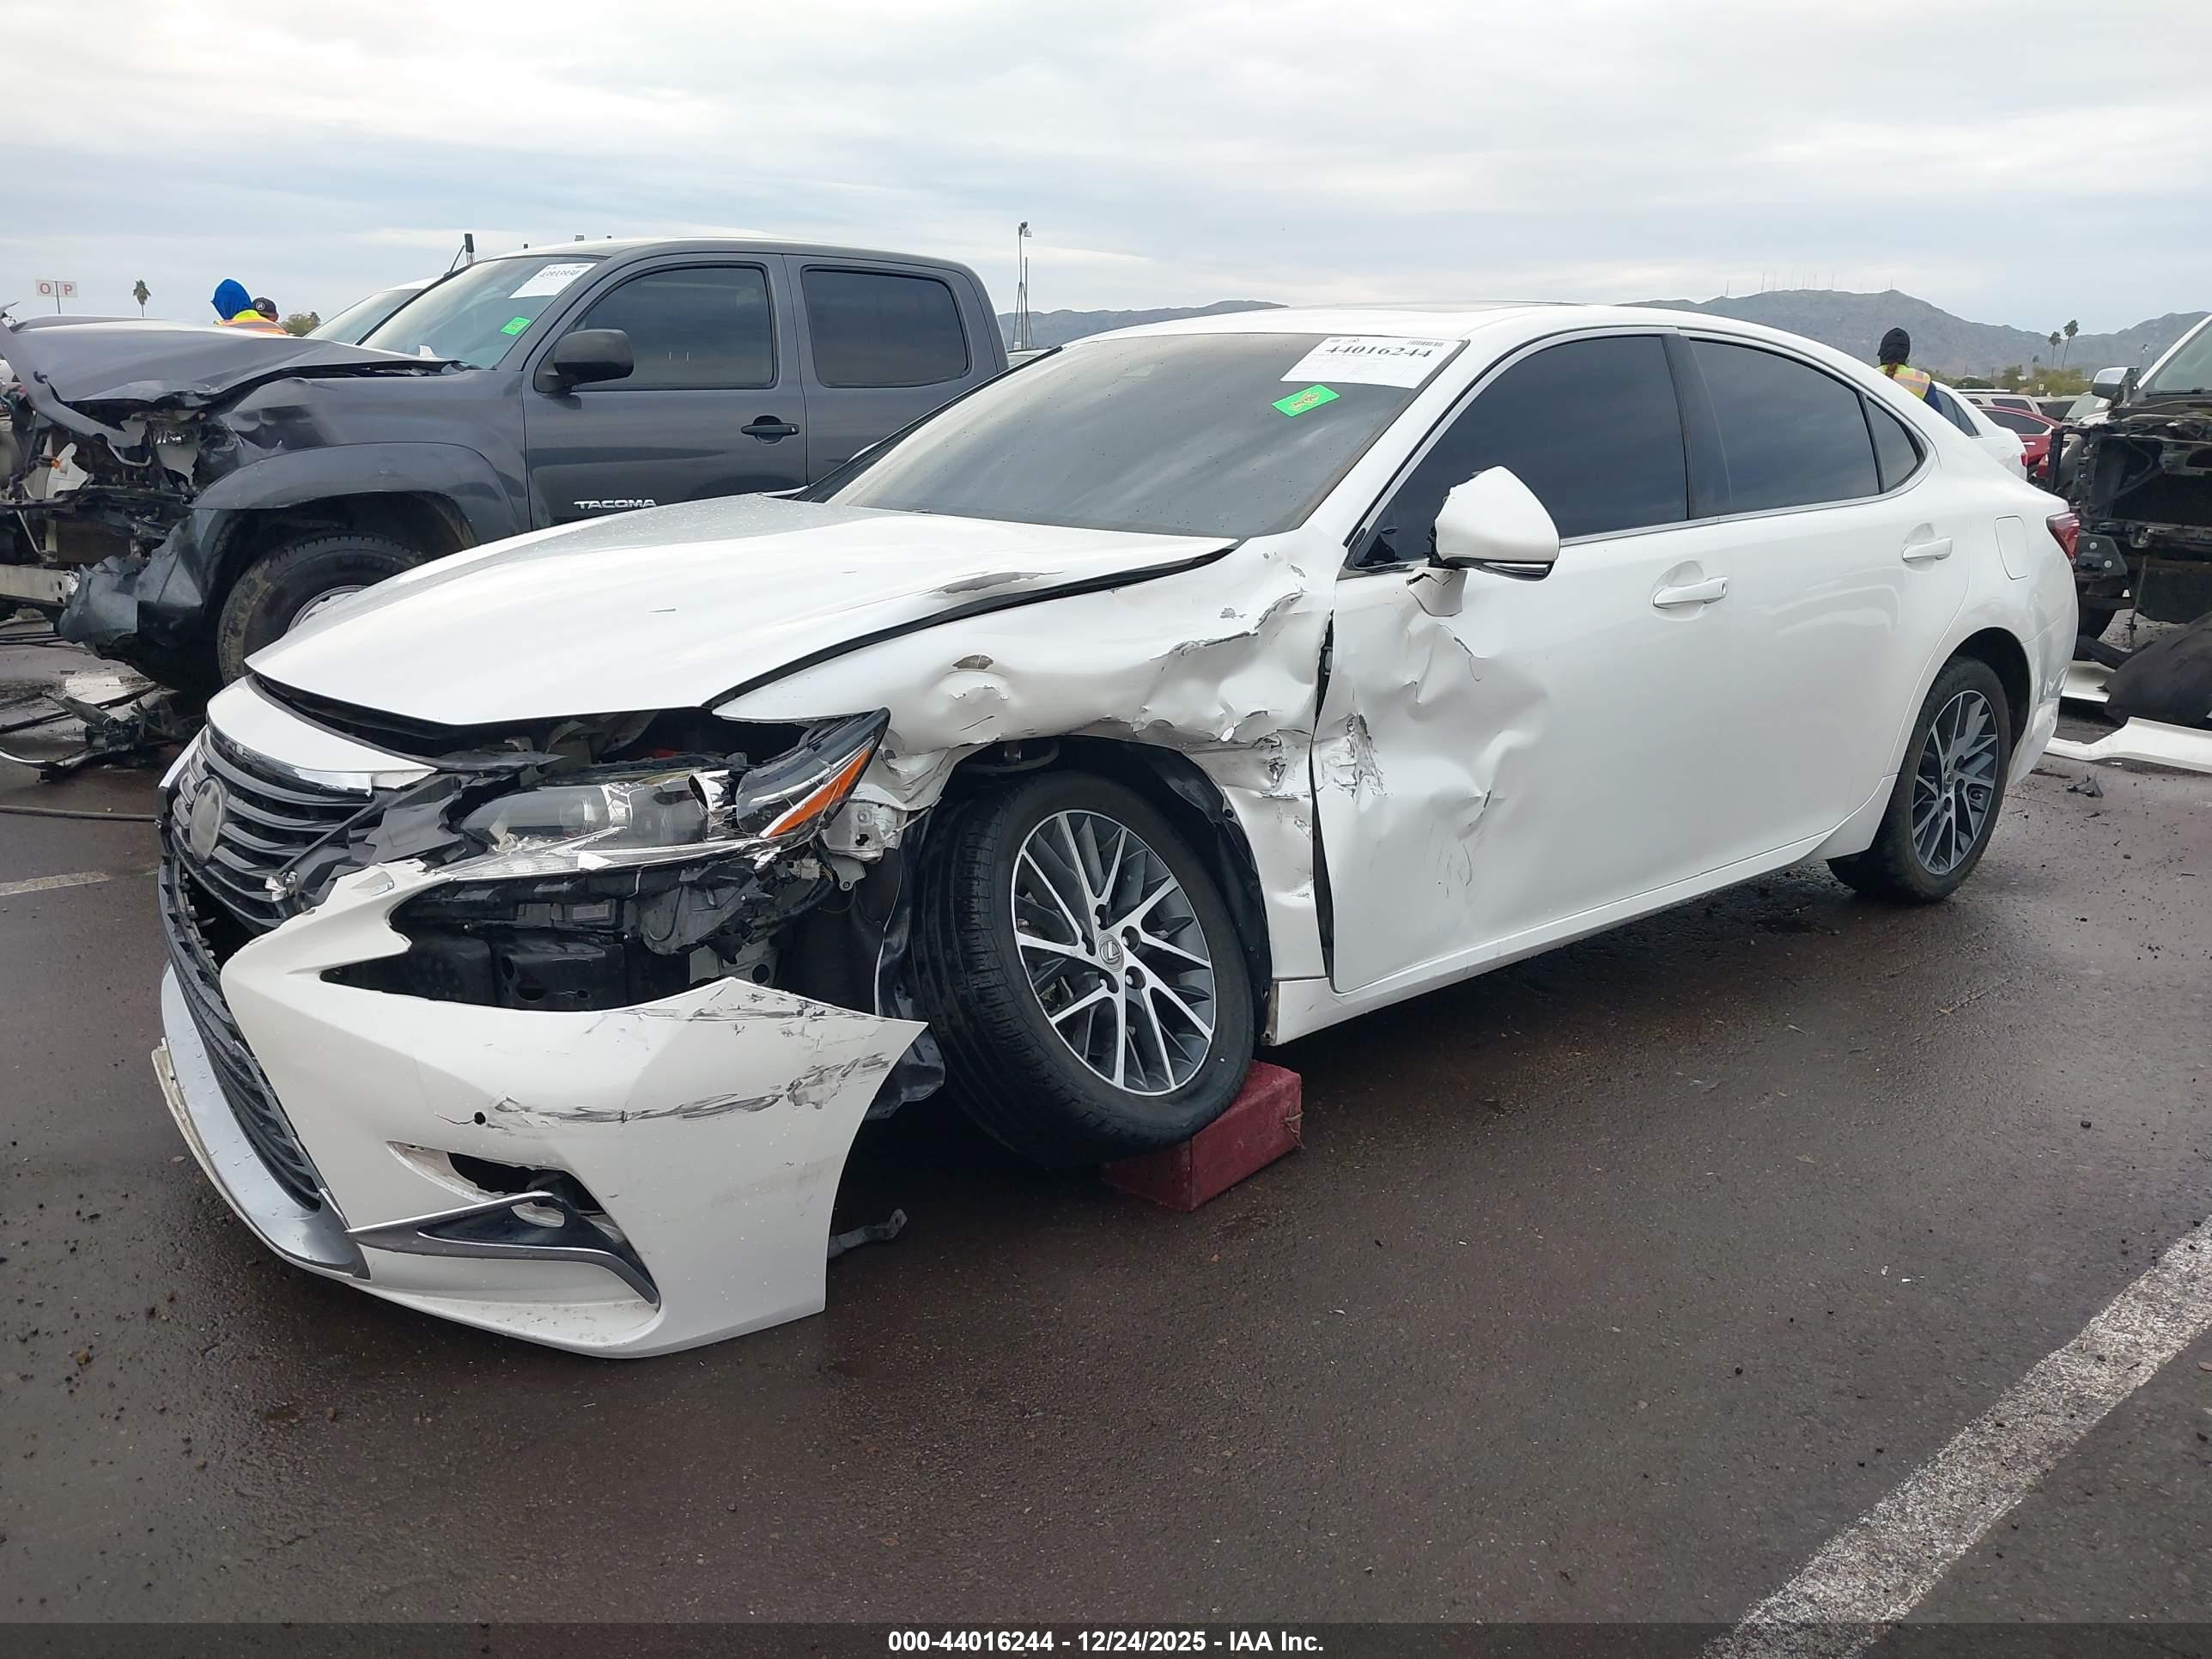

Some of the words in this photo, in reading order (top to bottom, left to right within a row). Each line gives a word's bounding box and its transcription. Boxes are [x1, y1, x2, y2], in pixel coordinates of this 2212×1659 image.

[40, 283, 52, 295] O
[64, 284, 73, 295] P
[1325, 345, 1433, 358] 44016244
[573, 499, 658, 510] TACOMA
